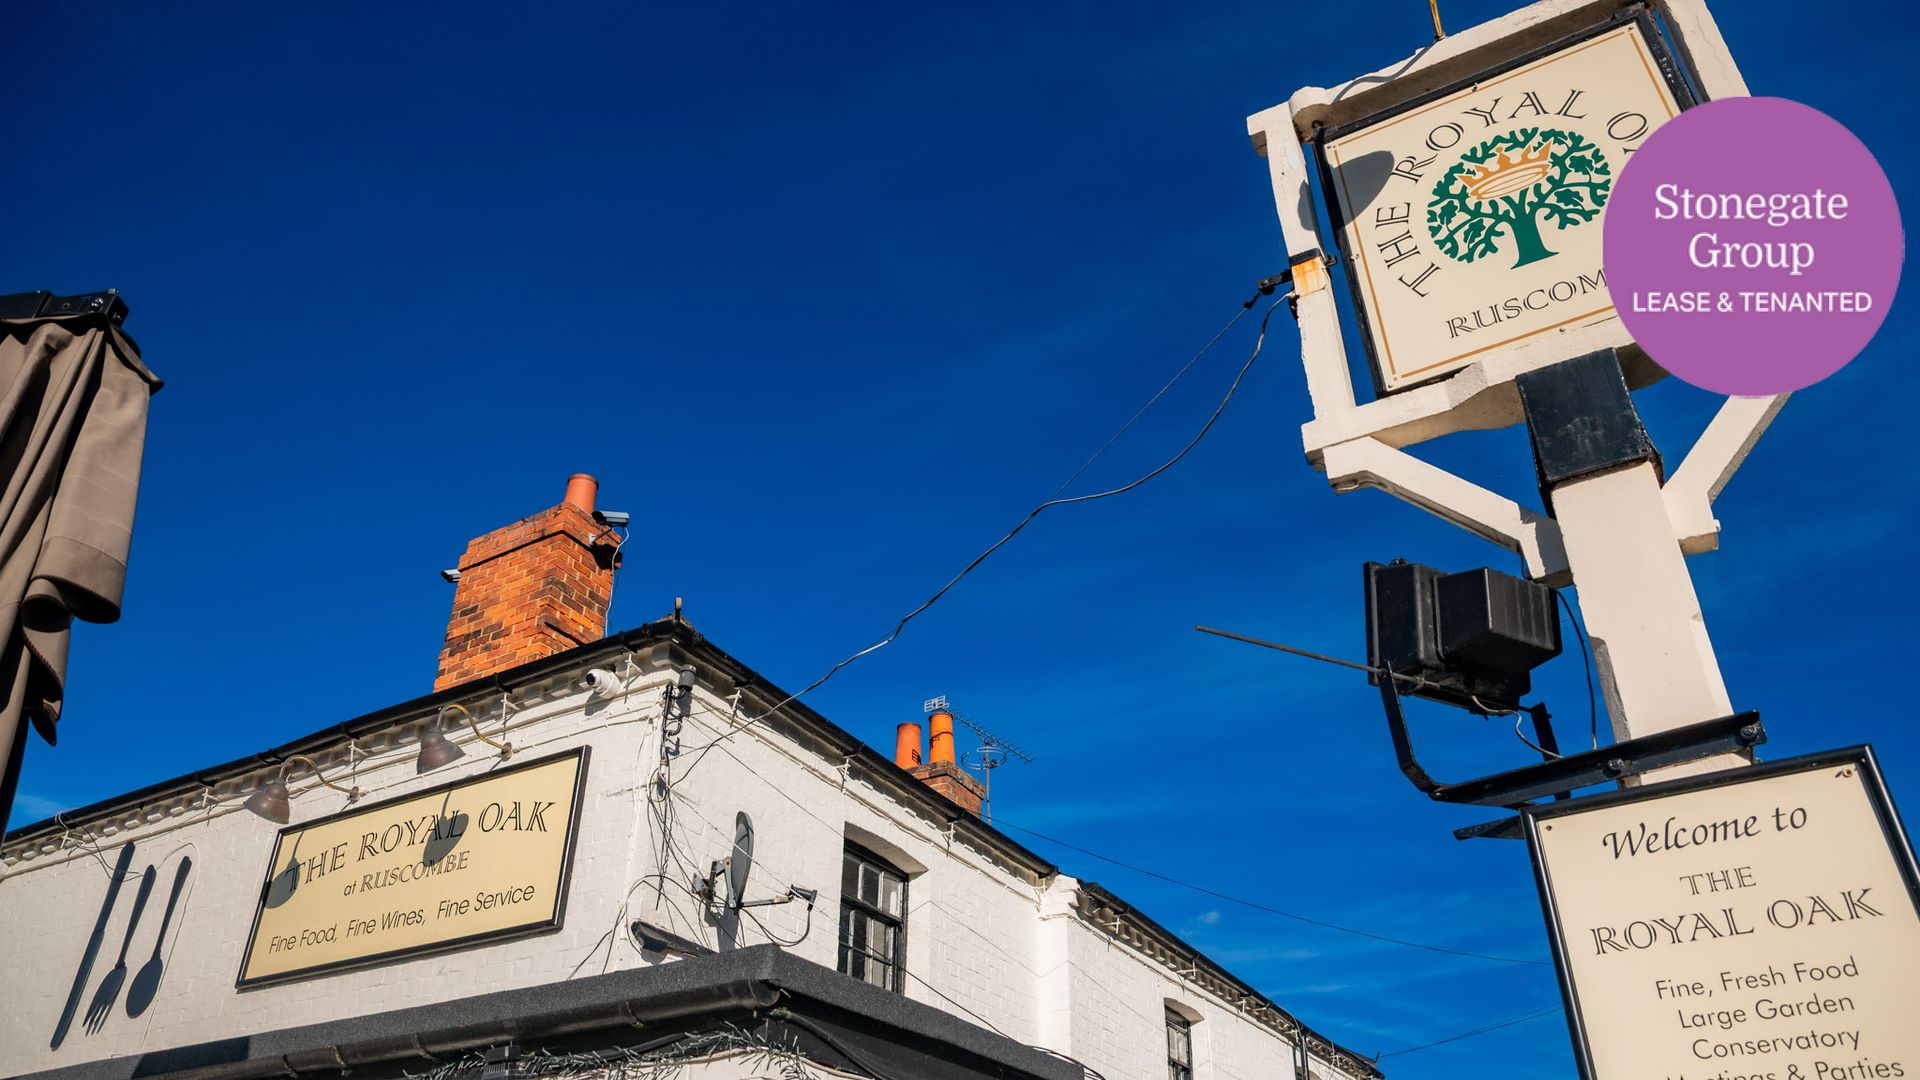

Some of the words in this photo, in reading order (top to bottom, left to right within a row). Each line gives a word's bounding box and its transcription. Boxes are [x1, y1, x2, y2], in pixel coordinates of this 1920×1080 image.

[1391, 88, 1590, 185] ROYAL
[1375, 201, 1442, 298] THE
[1445, 267, 1608, 339] RUSCOM
[285, 841, 348, 893] THE
[356, 809, 464, 863] ROYAL
[478, 801, 556, 833] OAK
[1602, 816, 1762, 860] Welcome
[1771, 806, 1808, 833] to
[343, 879, 357, 897] at
[359, 850, 471, 893] RUSCOMBE
[1679, 866, 1757, 896] THE
[269, 935, 297, 955] Fine
[299, 922, 338, 948] Food,
[346, 918, 377, 938] Fine
[380, 908, 426, 932] Wines,
[436, 899, 470, 920] Fine
[473, 884, 535, 912] Service
[1589, 907, 1755, 956] ROYAL
[1766, 887, 1886, 930] OAK
[1655, 978, 1713, 1000] Fine,
[1720, 965, 1787, 992] Fresh
[1793, 955, 1860, 983] Food
[1677, 1009, 1748, 1030] Large
[1755, 992, 1855, 1020] Garden
[1692, 1030, 1860, 1060] Conservatory
[1814, 1057, 1905, 1080] Parties
